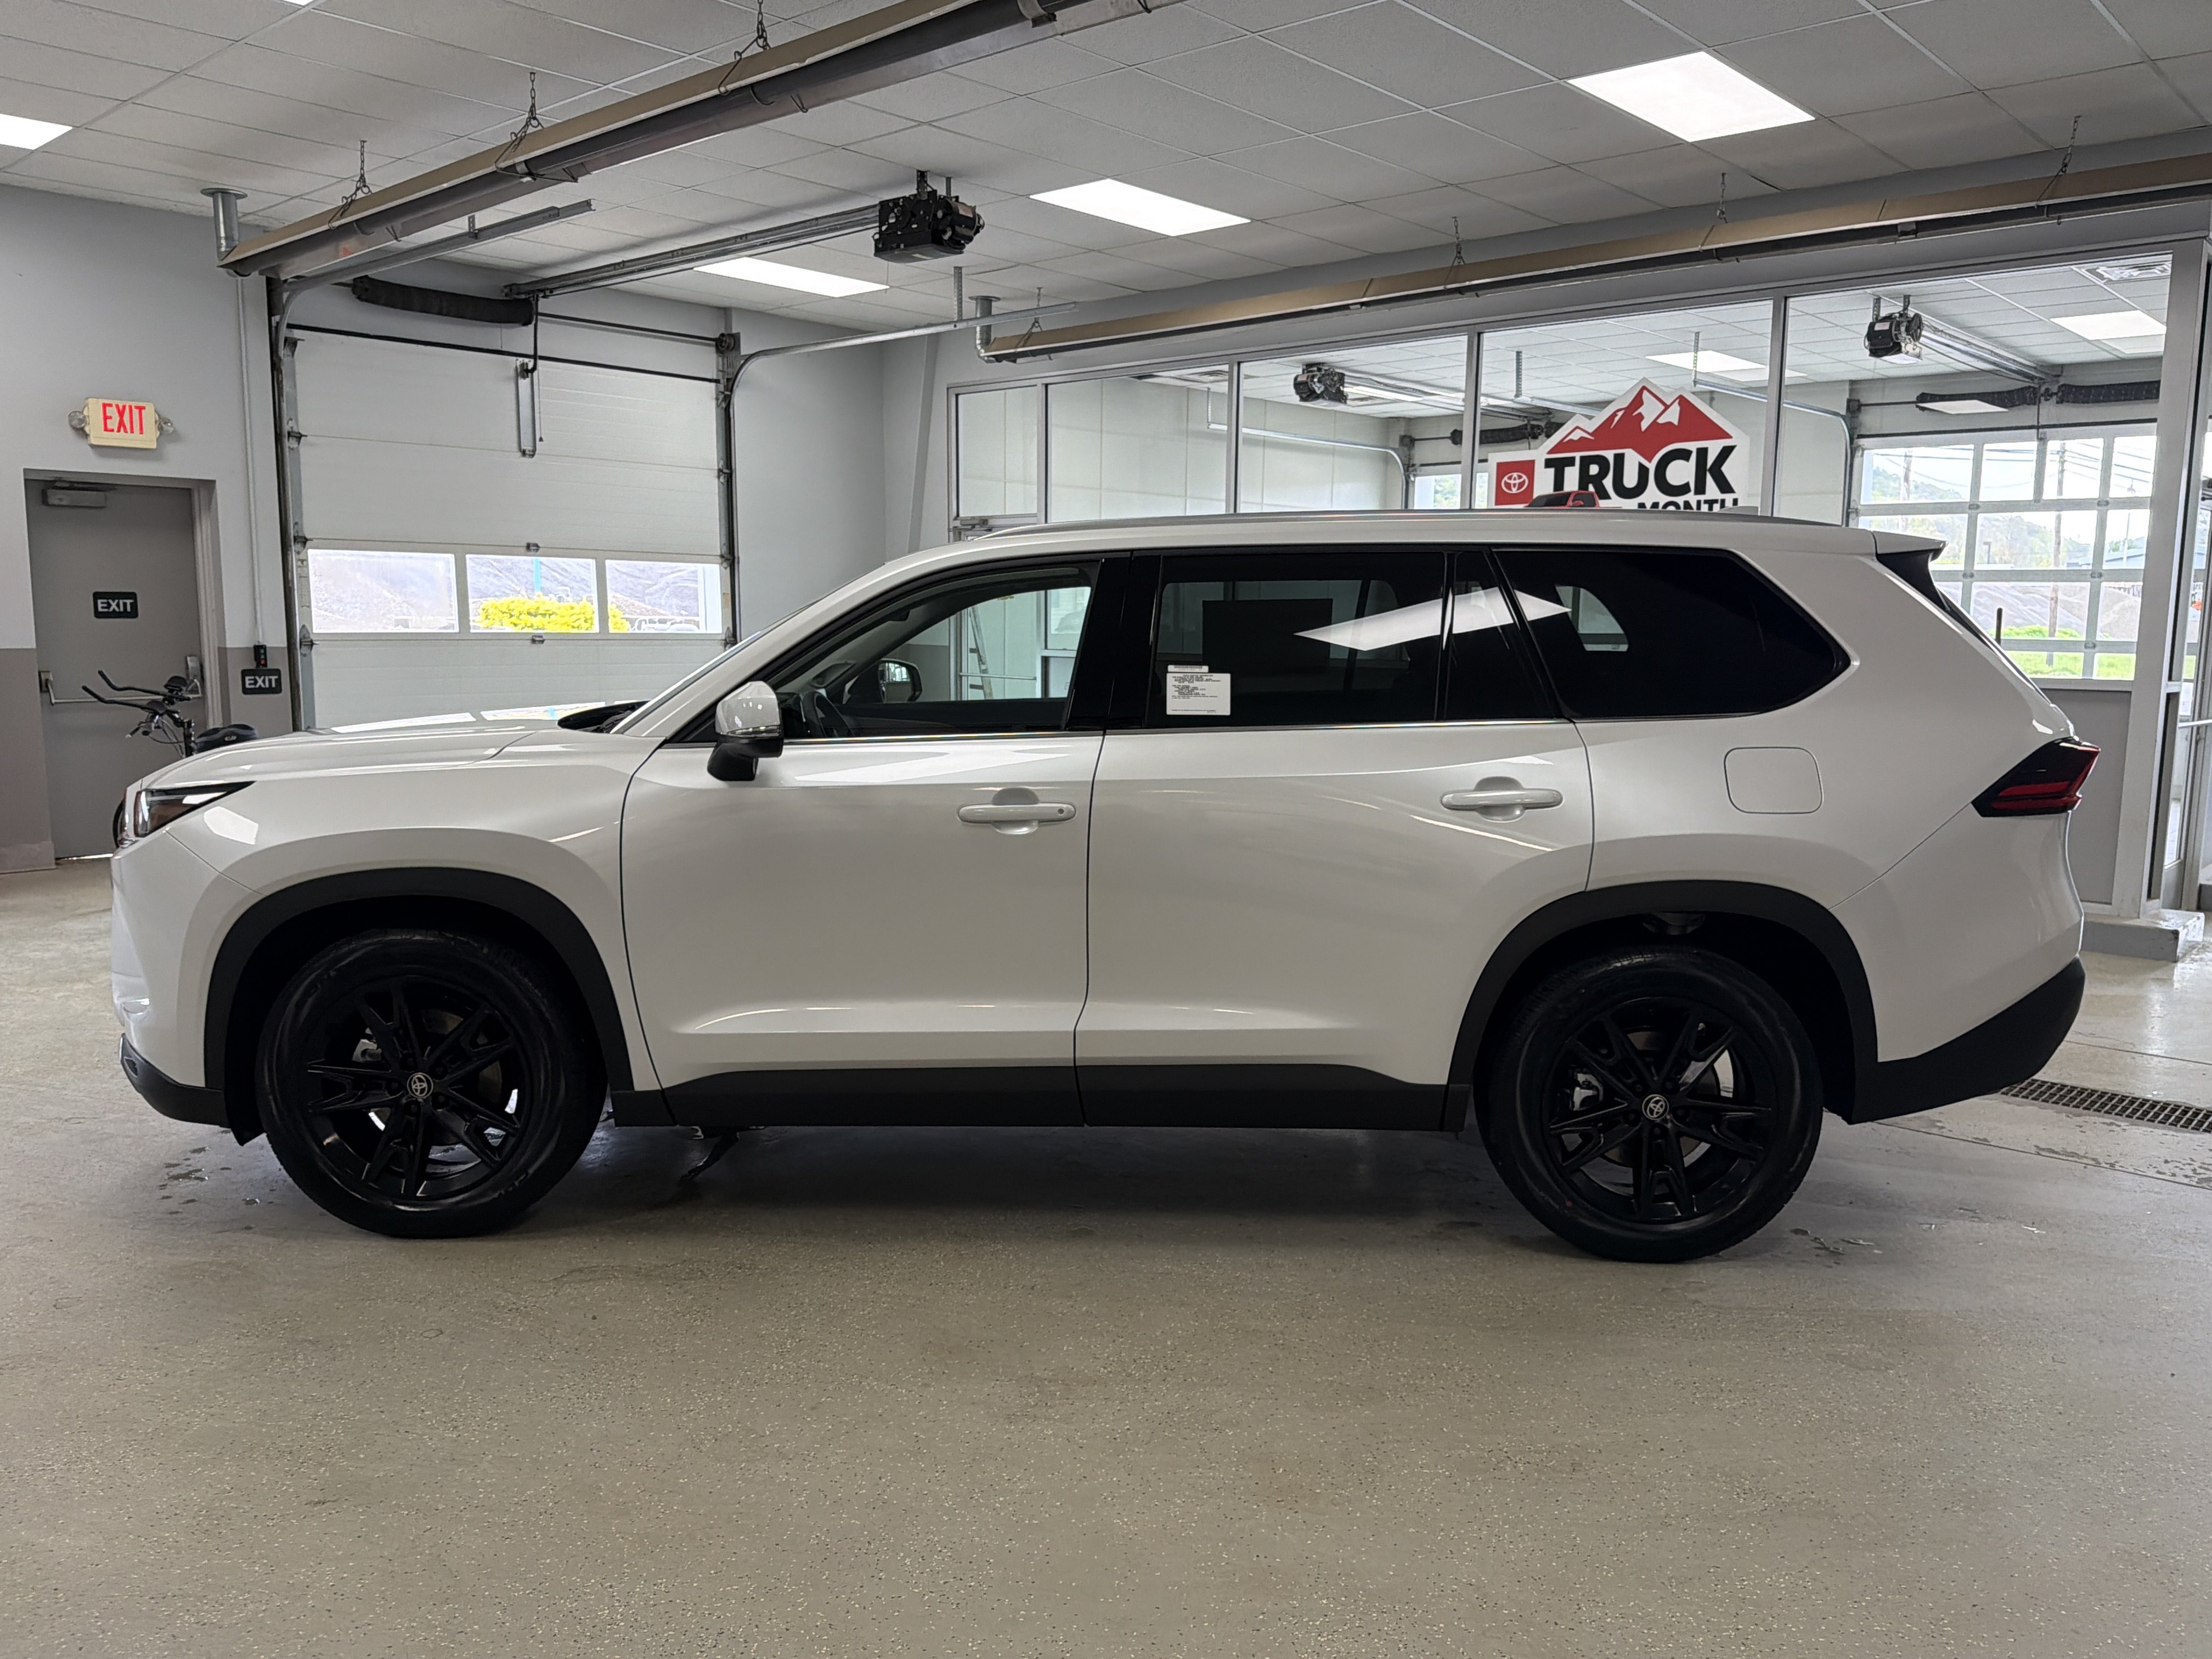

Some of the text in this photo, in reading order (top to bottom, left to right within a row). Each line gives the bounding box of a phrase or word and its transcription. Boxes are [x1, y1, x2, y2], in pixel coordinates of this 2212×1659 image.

[102, 403, 146, 435] EXIT
[1544, 445, 1737, 500] TRUCK
[97, 599, 134, 612] EXIT
[245, 675, 279, 689] EXIT
